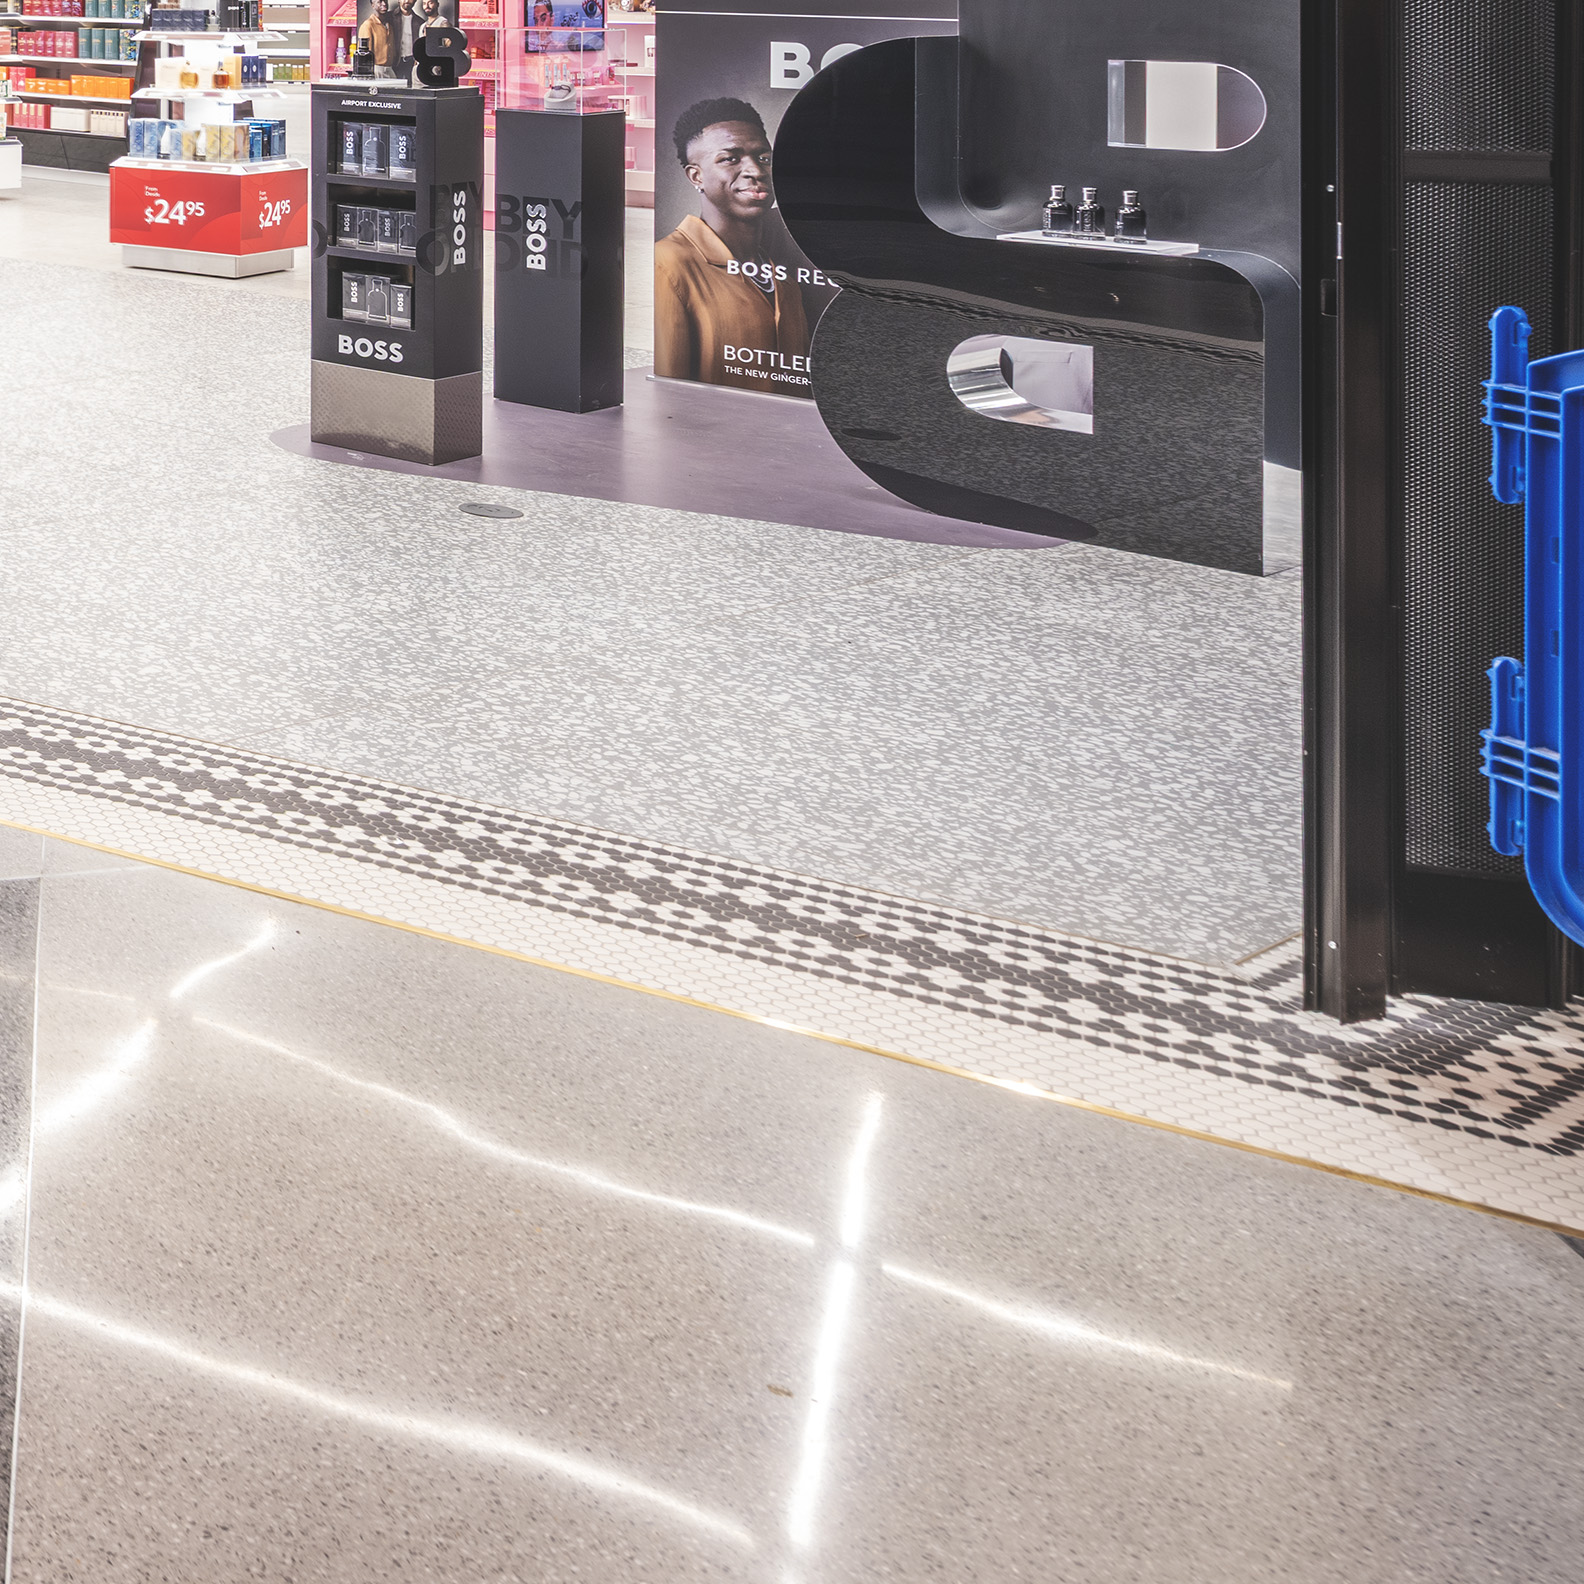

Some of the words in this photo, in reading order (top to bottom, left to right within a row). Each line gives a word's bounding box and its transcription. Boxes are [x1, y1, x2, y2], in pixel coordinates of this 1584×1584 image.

[368, 101, 401, 109] EXCLUSIVE
[453, 190, 466, 265] BOSS
[526, 203, 547, 270] BOSS
[727, 260, 787, 281] BOSS
[338, 334, 404, 363] BOSS
[723, 345, 811, 373] BOTTLE
[725, 365, 743, 375] THE
[745, 369, 768, 379] NEW
